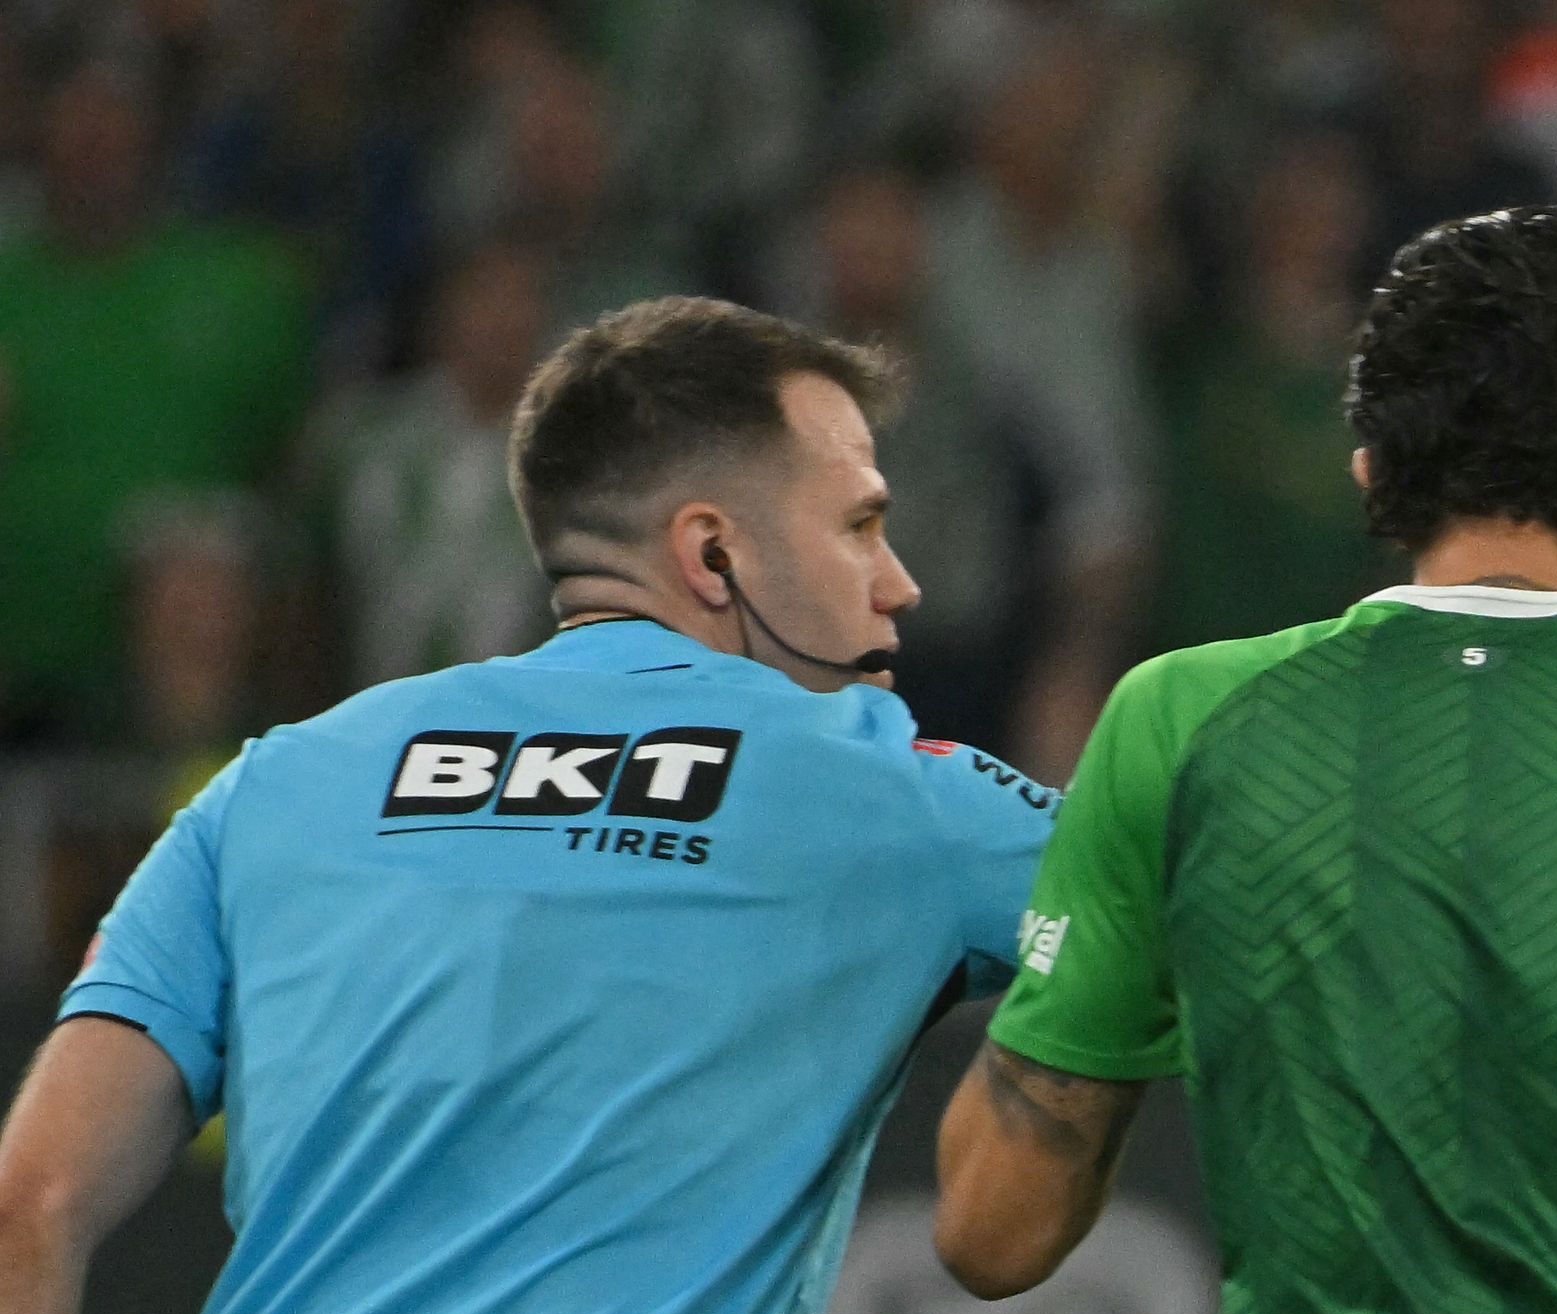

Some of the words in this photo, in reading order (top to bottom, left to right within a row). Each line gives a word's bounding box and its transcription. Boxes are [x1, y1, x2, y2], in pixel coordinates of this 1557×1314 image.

[1461, 647, 1487, 665] 5
[392, 741, 731, 801] BKT
[565, 826, 713, 866] TIRES
